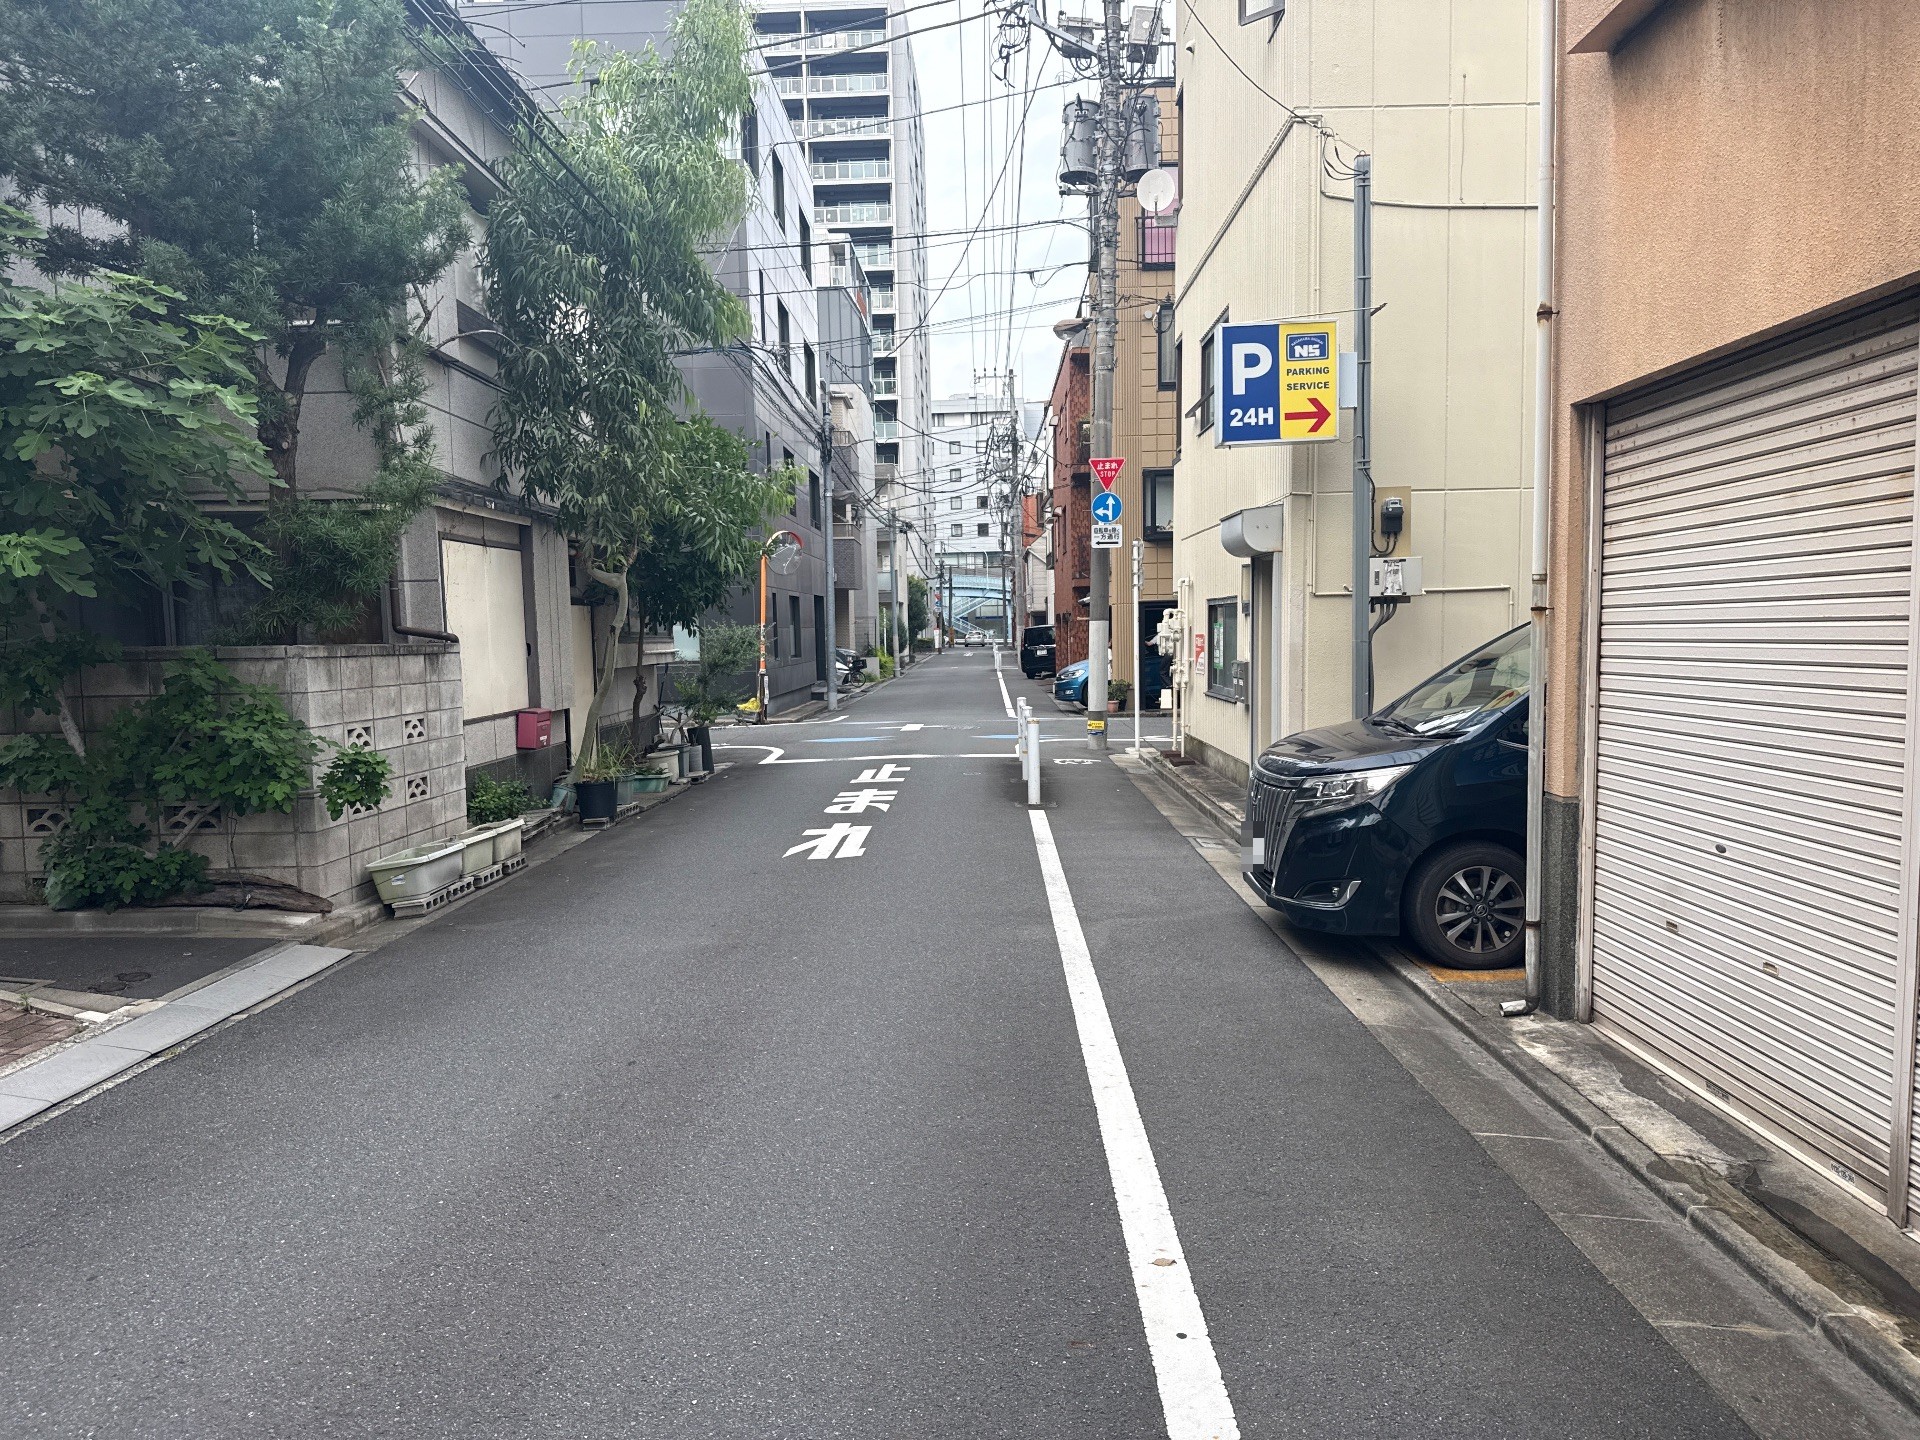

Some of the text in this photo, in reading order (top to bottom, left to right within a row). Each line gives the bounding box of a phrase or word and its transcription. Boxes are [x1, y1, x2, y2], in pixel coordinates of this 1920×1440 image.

[1294, 345, 1320, 357] NS
[1232, 343, 1272, 395] P
[1286, 367, 1329, 376] PARKING
[1286, 382, 1329, 390] SERVICE
[1230, 407, 1273, 426] 24H
[1097, 462, 1118, 470] 止まれ
[782, 763, 911, 860] 止まれ
